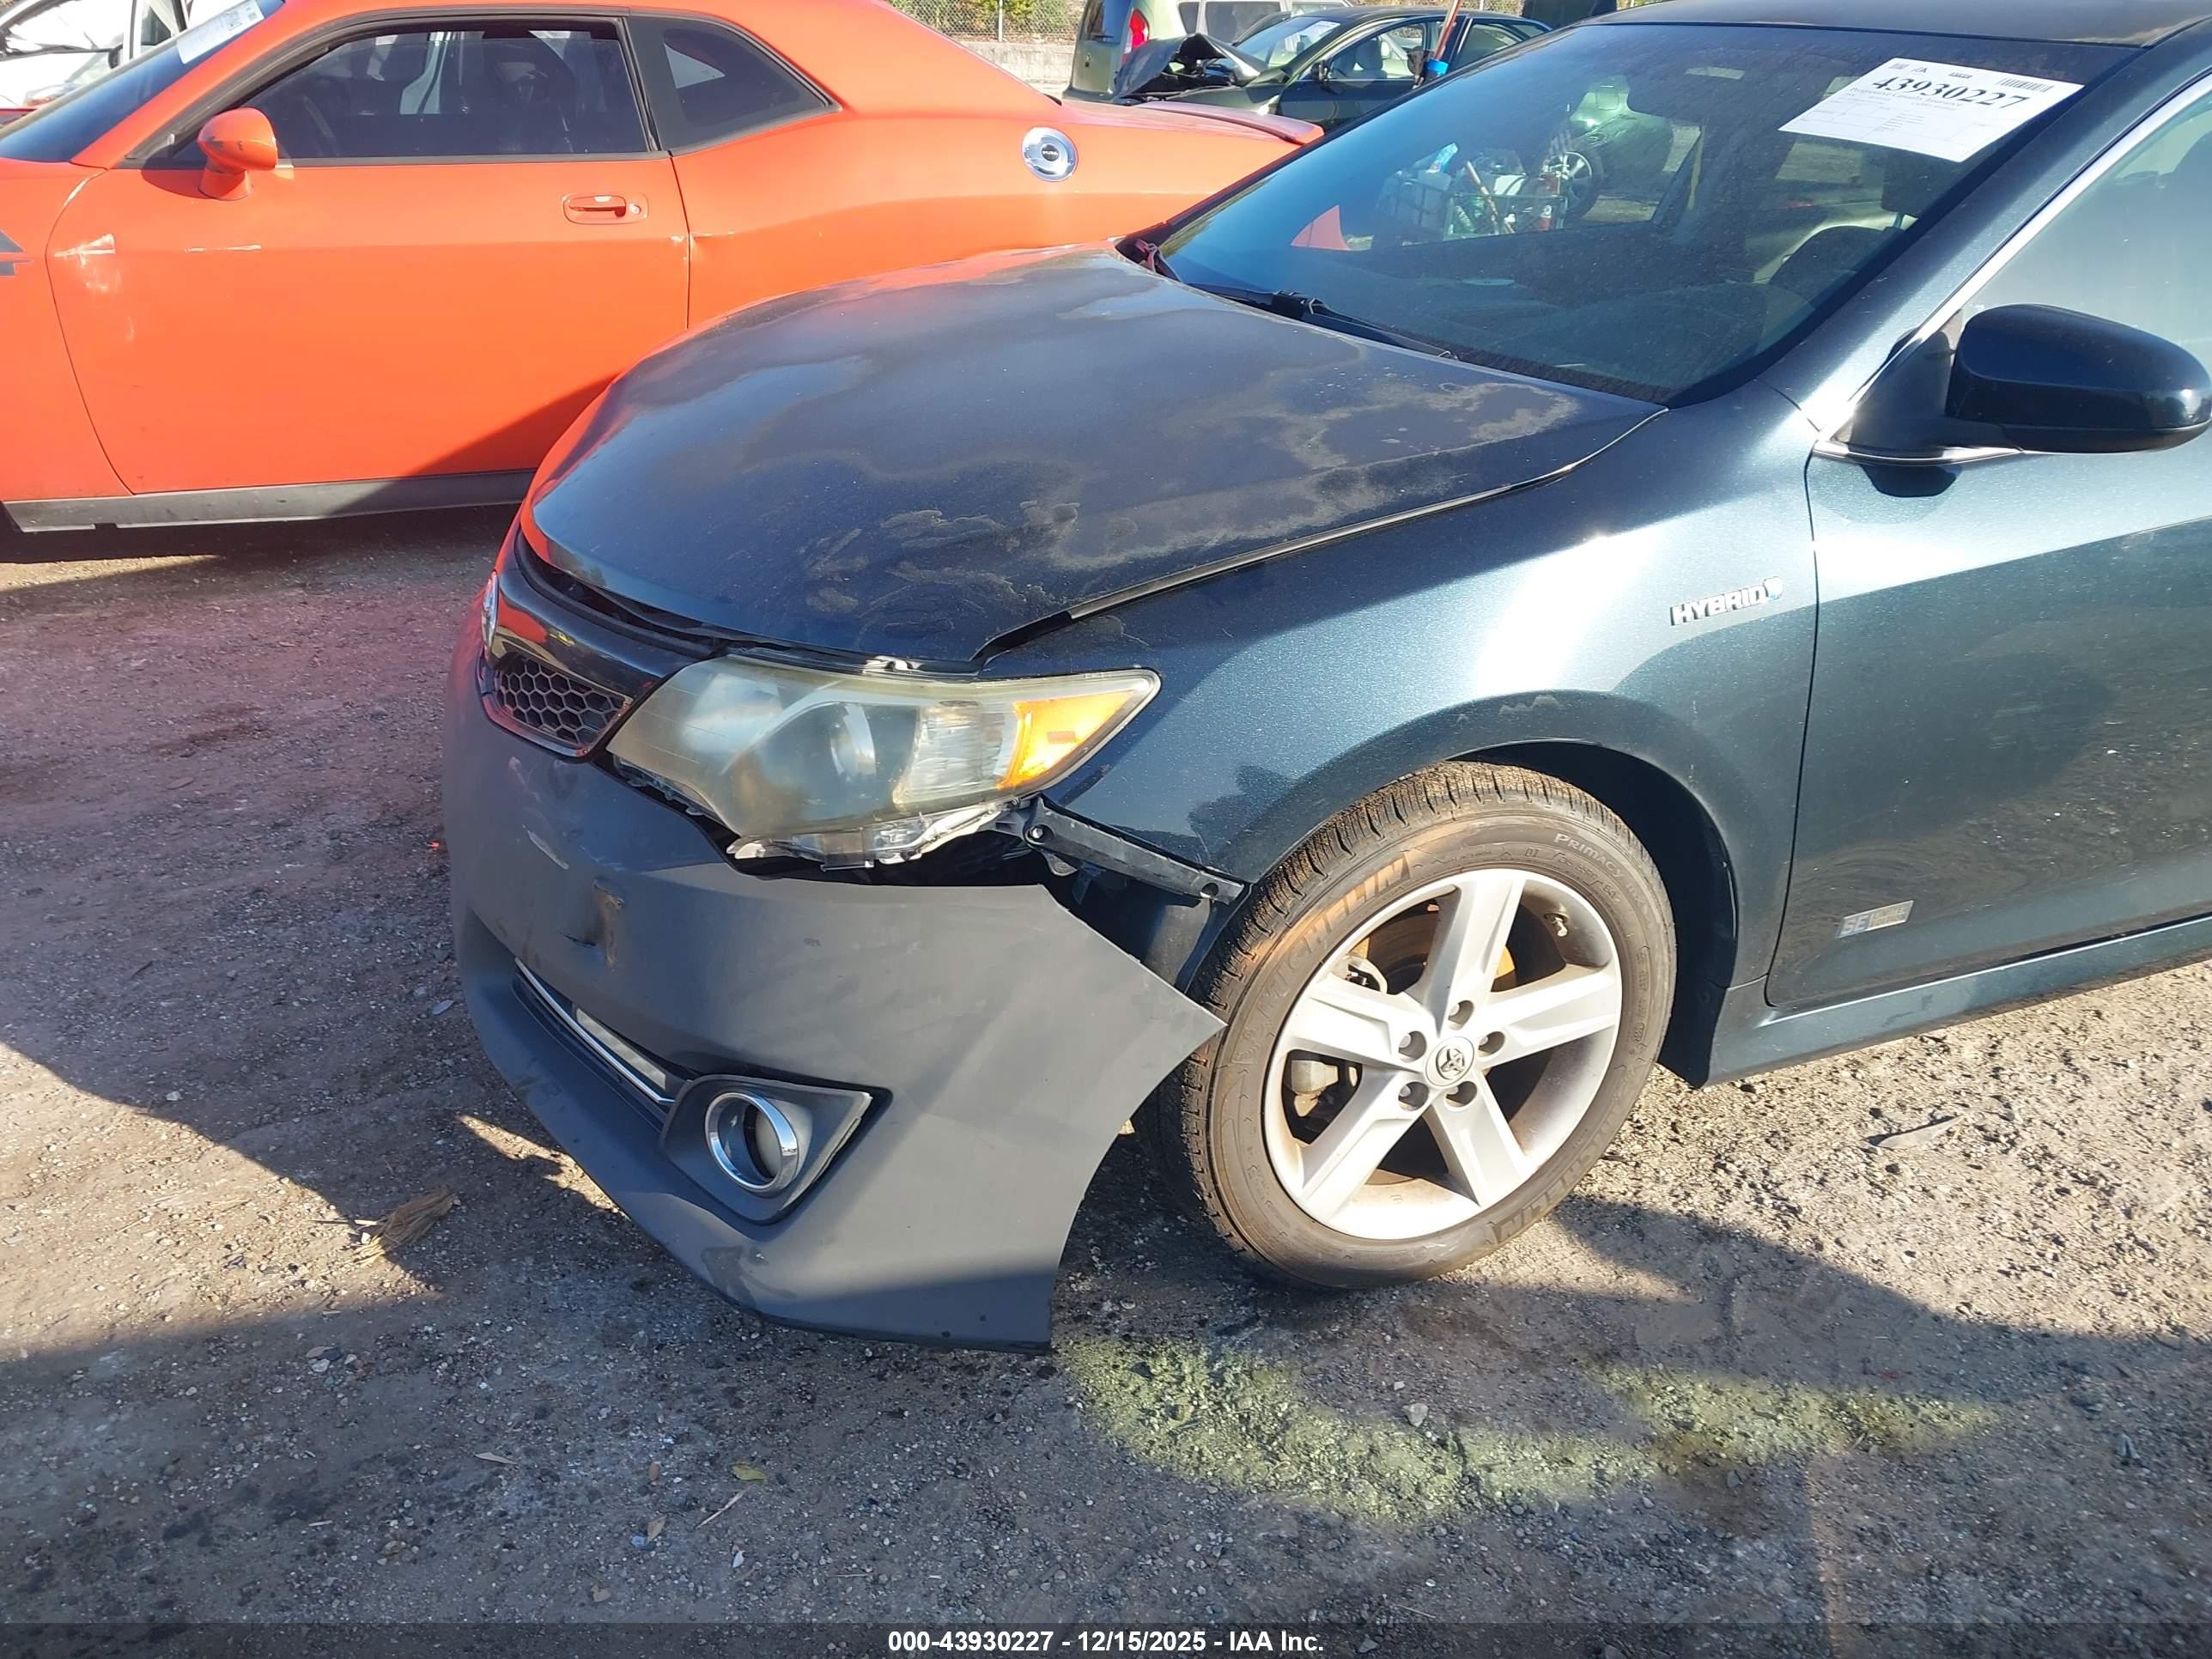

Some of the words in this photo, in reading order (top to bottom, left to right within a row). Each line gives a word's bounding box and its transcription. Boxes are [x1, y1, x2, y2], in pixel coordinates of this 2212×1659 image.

[1871, 76, 2030, 108] 43930227
[1670, 585, 1768, 626] HYBRID
[1553, 833, 1625, 879] PRIMACY
